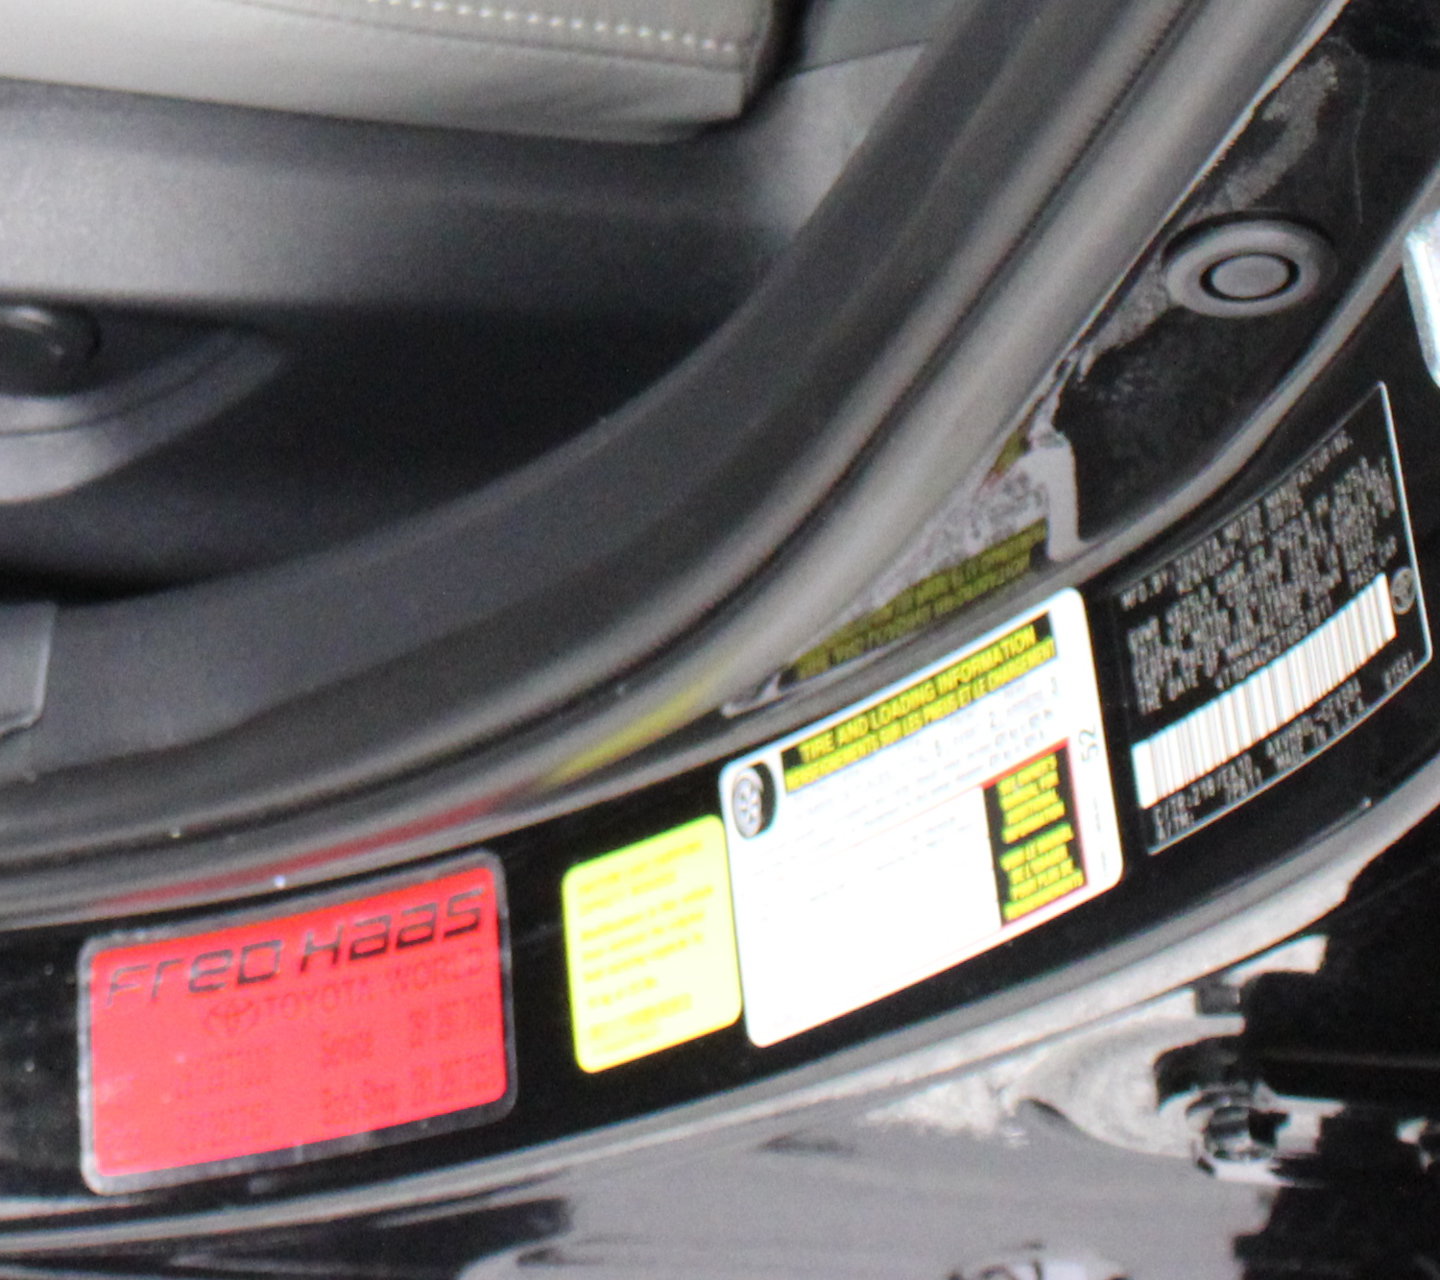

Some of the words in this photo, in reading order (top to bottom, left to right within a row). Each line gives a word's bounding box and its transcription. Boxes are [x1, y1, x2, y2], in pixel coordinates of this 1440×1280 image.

[798, 728, 834, 765] TIRE
[835, 710, 869, 747] AND
[869, 675, 937, 730] LOADING
[935, 623, 1035, 697] INFORMATION
[262, 980, 379, 1023] TOYOTA
[389, 948, 485, 999] WORLD
